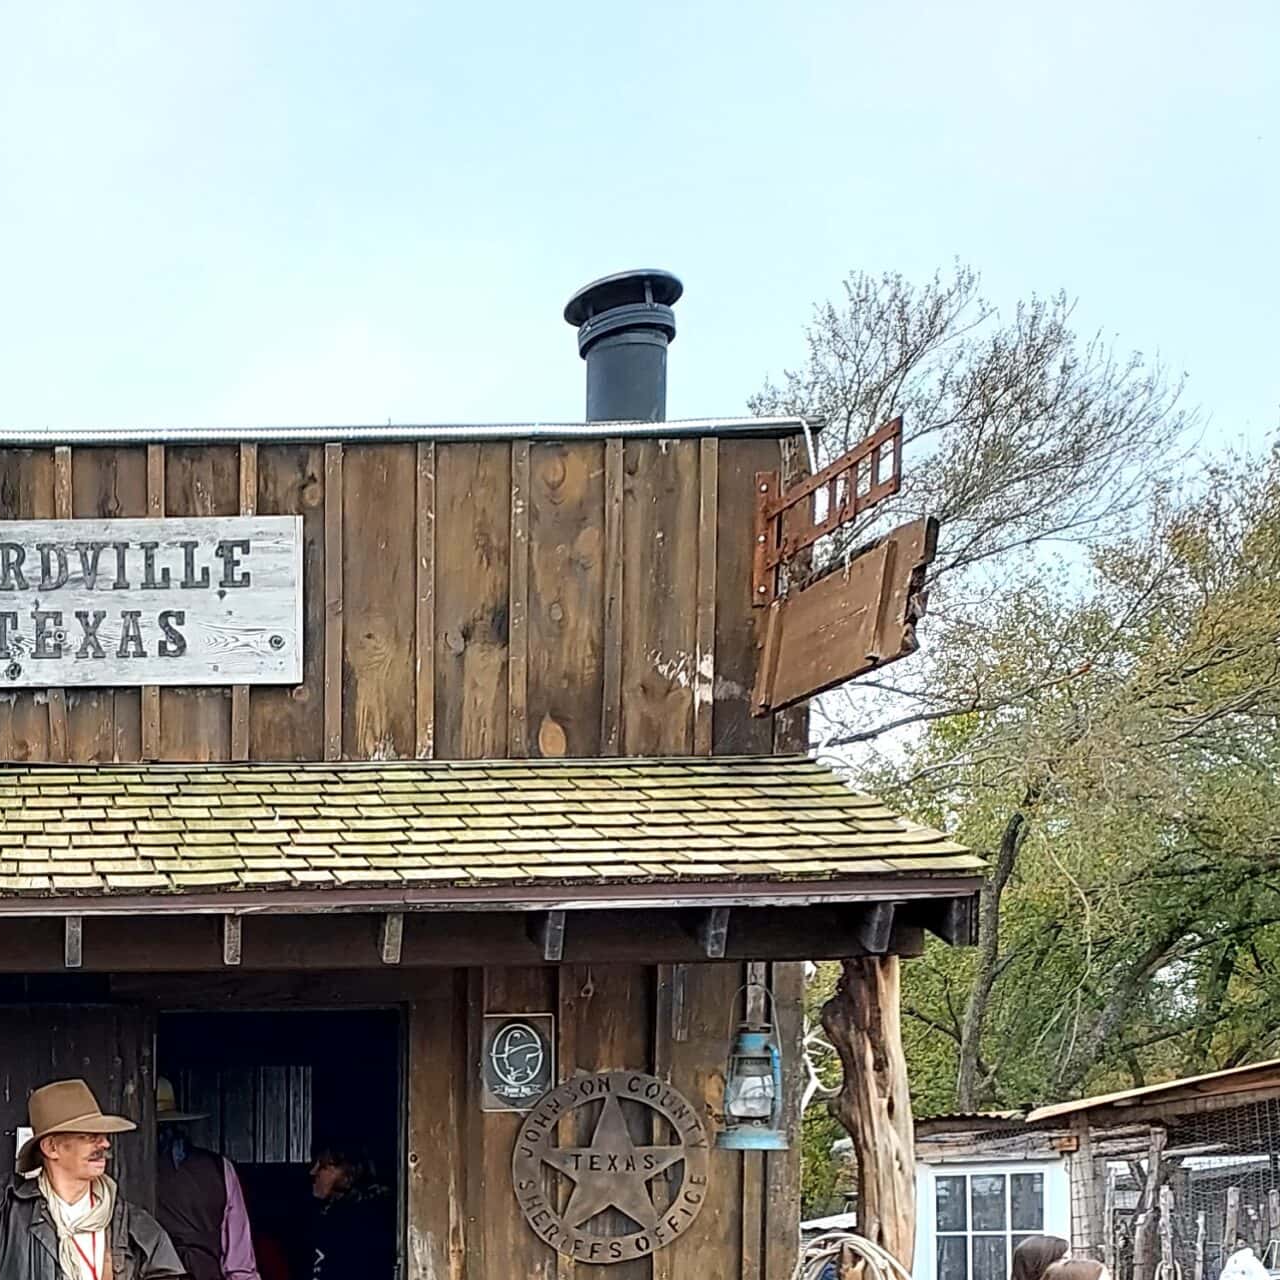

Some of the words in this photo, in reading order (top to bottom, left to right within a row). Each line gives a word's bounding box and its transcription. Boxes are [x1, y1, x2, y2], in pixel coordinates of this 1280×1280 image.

[520, 1077, 612, 1159] JOHNSON
[627, 1076, 709, 1150] COUNTY
[571, 1154, 657, 1172] TEXAS
[519, 1179, 623, 1259] SHERIFFS
[635, 1174, 707, 1252] OFFICE
